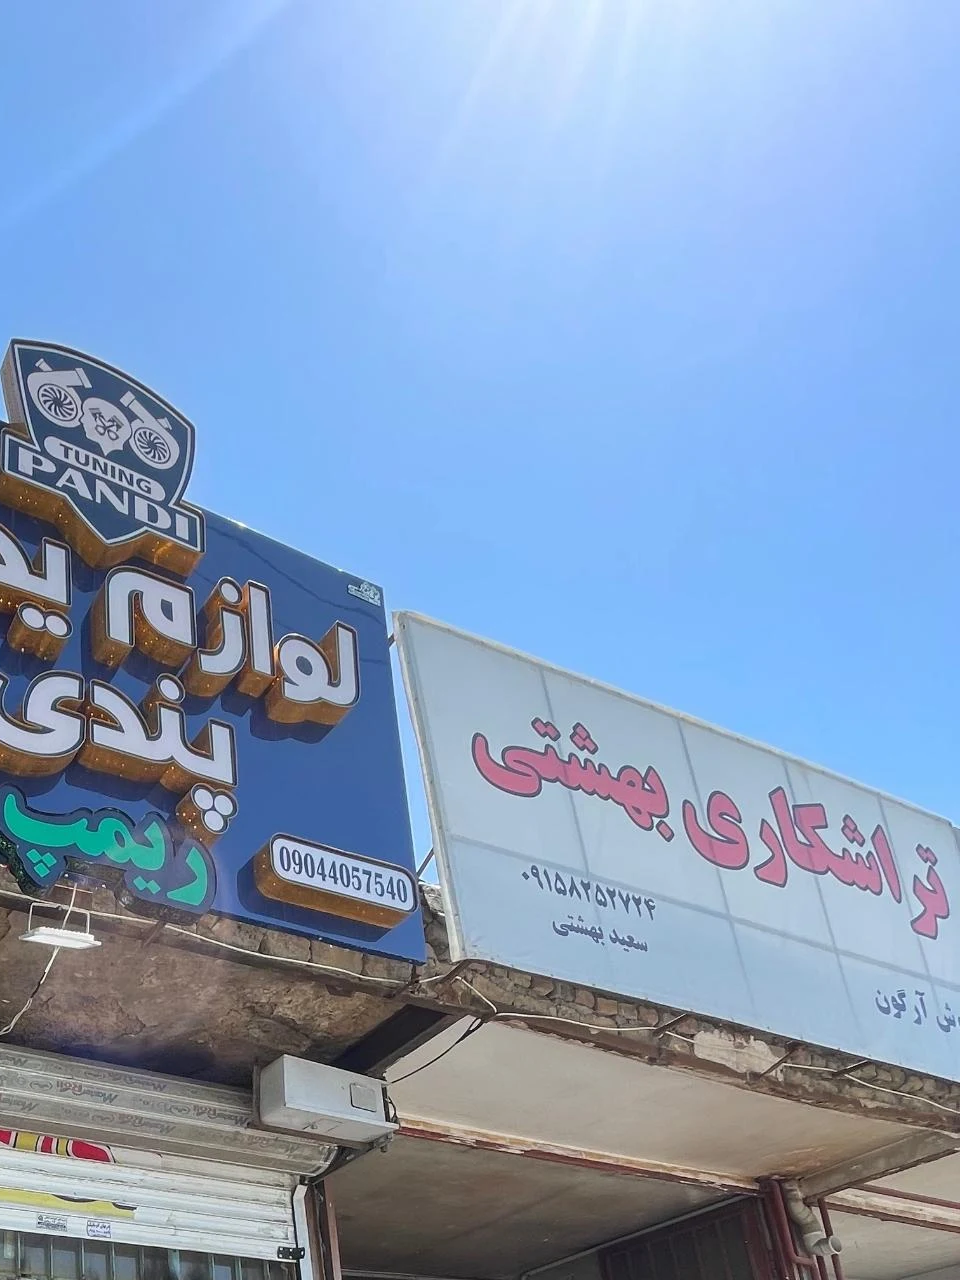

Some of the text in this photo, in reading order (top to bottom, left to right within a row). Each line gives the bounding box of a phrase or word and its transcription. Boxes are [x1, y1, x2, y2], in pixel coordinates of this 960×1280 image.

[17, 446, 190, 541] PANDI
[58, 443, 152, 496] TUNING
[106, 564, 361, 708] لوازم
[471, 717, 674, 842] بهشتی
[2, 790, 211, 907] ریمپ
[279, 846, 408, 903] 09044057540
[552, 915, 648, 952] سعید بهشتی
